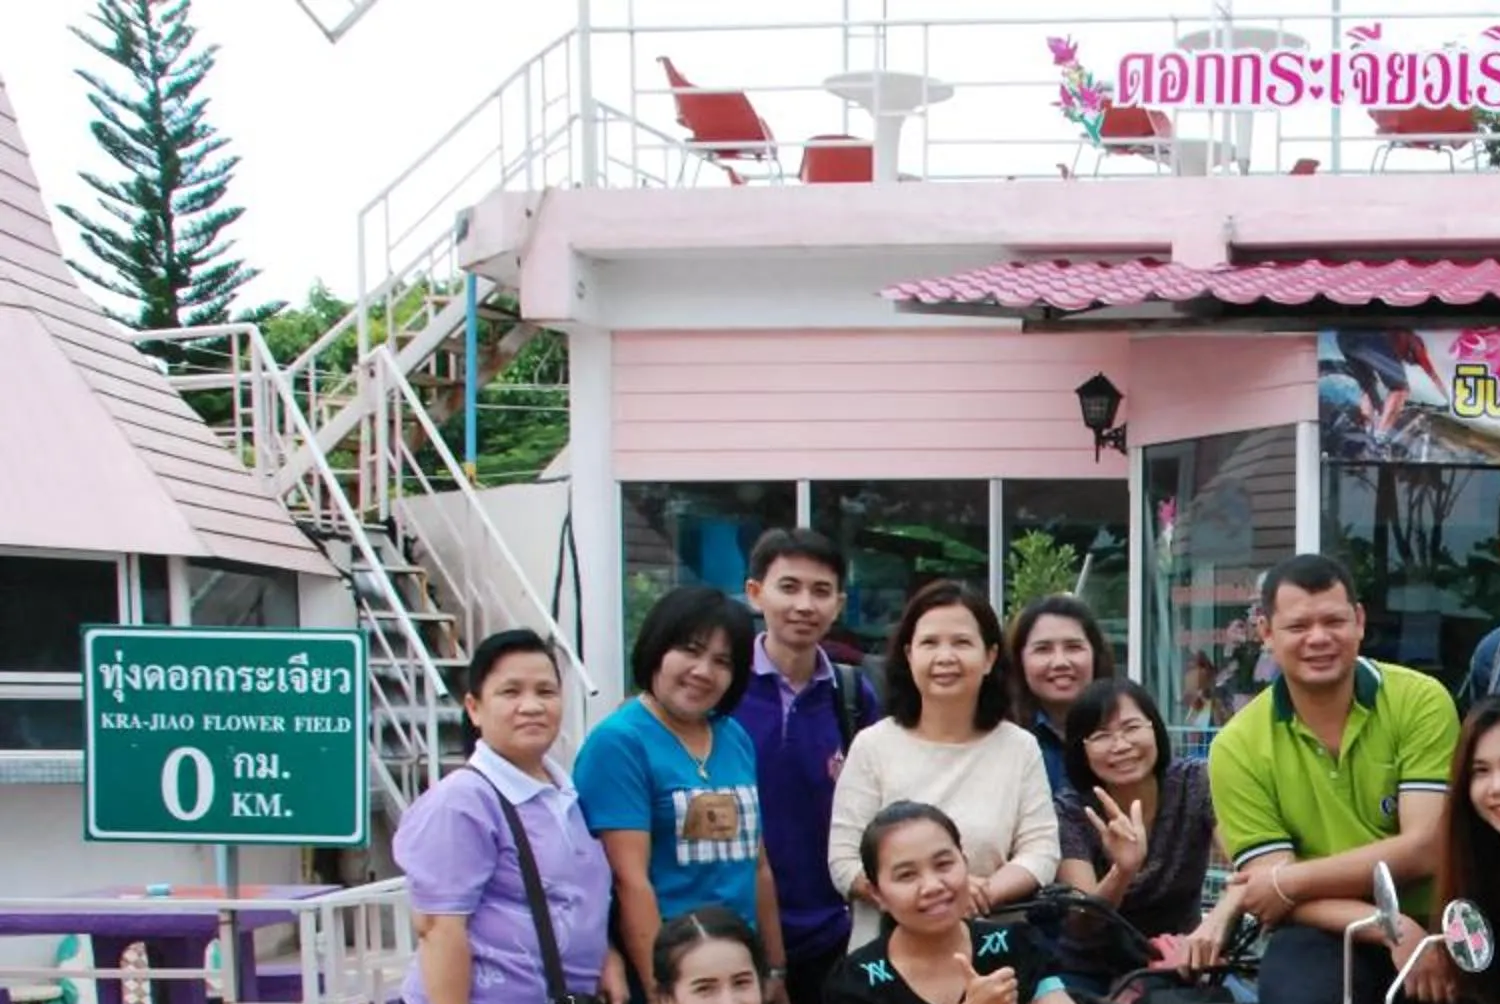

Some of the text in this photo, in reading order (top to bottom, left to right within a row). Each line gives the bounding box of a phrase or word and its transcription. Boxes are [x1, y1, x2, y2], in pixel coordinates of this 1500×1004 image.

[100, 713, 352, 733] KRA-JIAO FLOWER FIELD
[233, 752, 291, 779] กม.
[160, 746, 215, 821] 0
[231, 793, 294, 818] KM.
